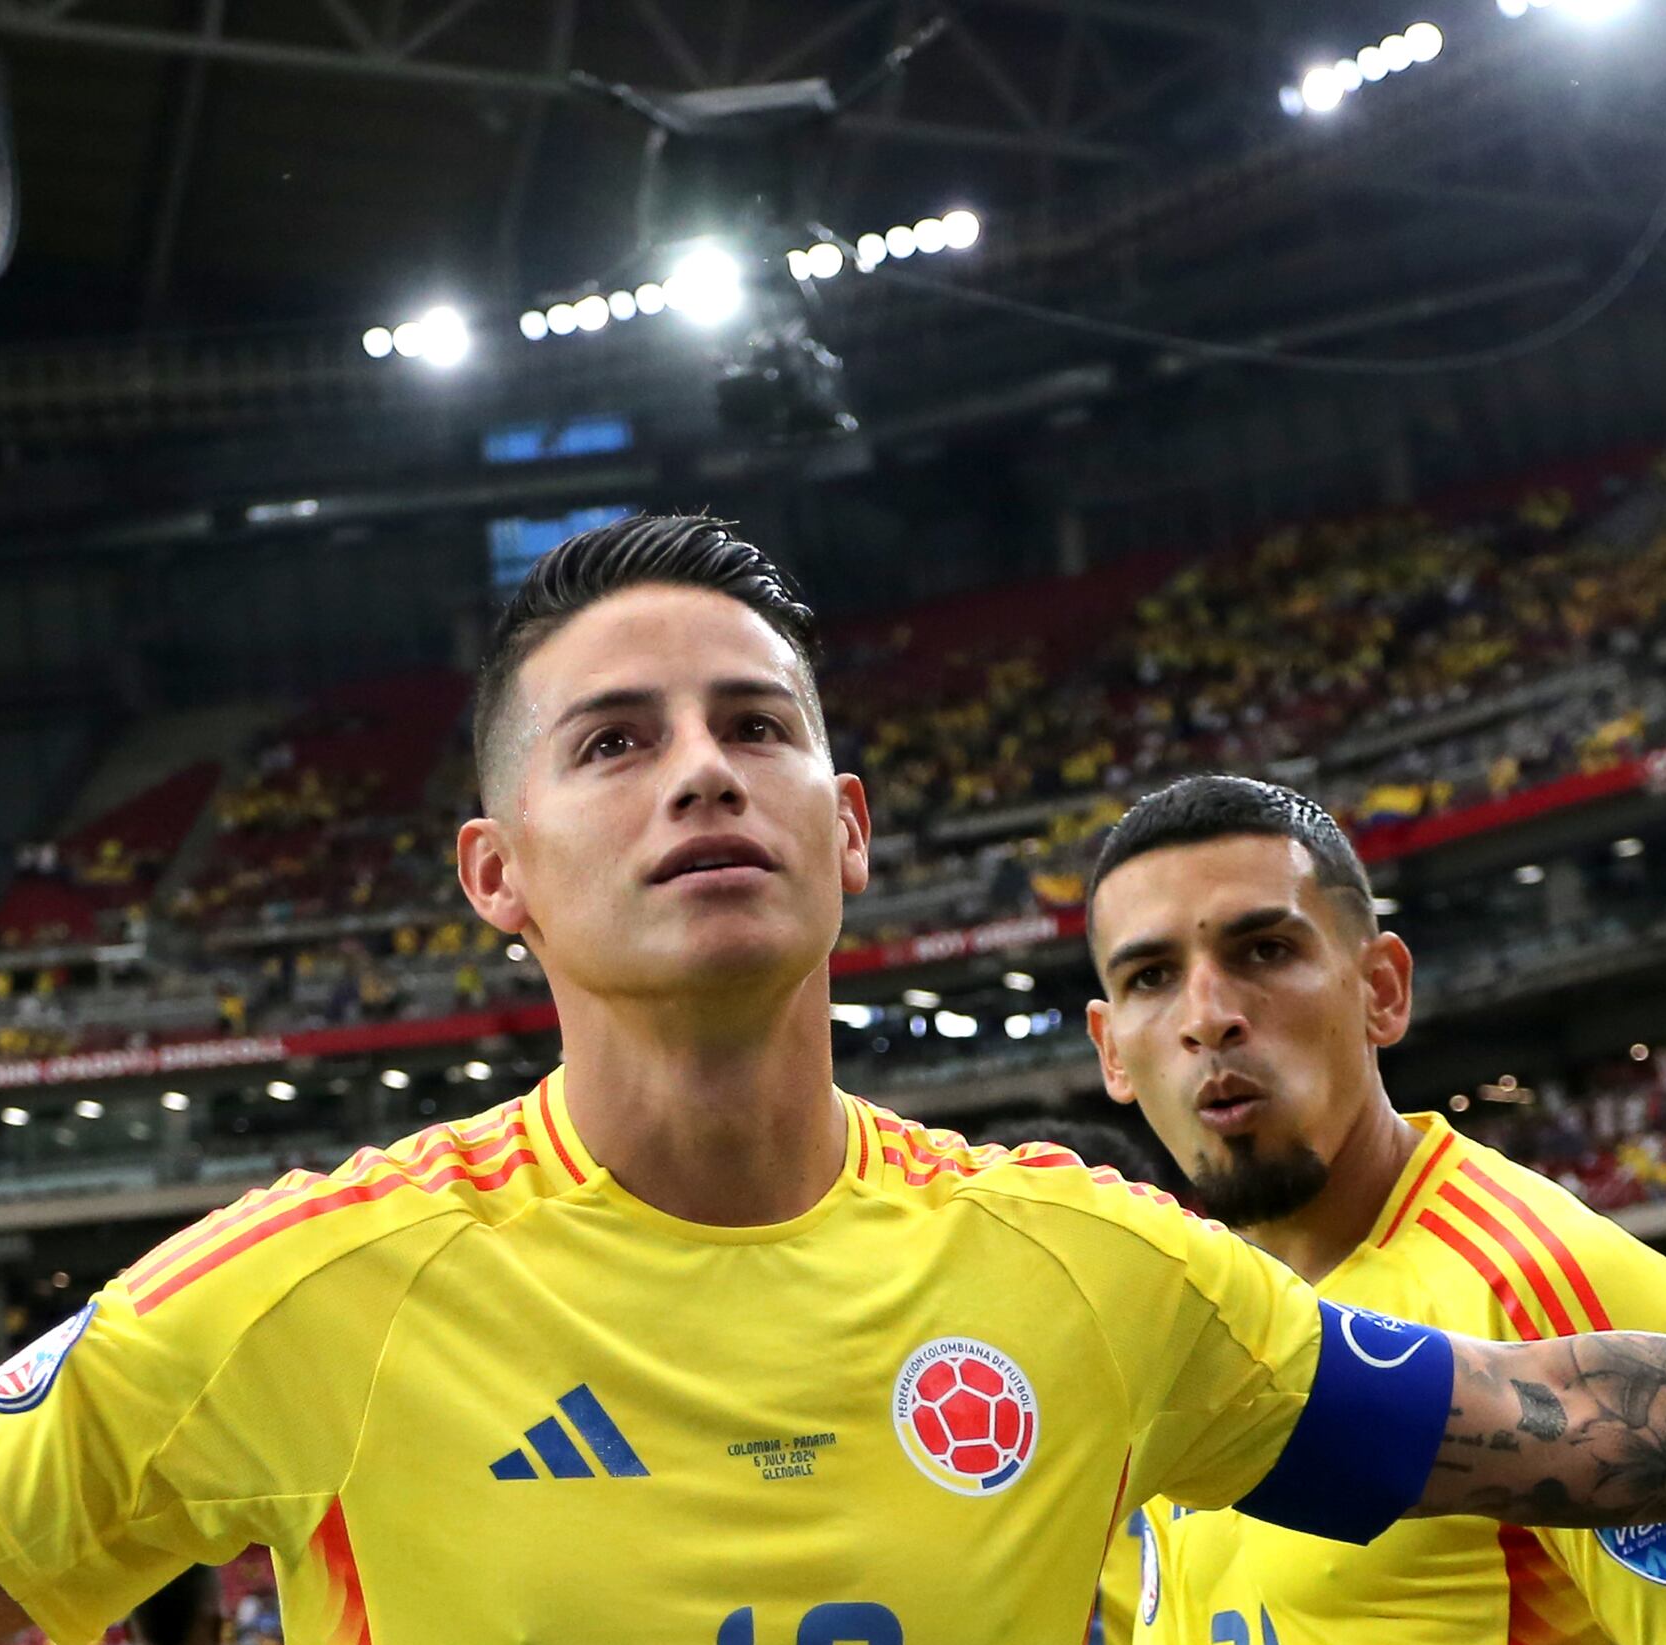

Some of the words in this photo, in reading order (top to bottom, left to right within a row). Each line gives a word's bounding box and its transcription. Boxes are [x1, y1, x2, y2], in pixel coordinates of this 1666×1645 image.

[923, 1342, 991, 1362] COLOMBIANA
[992, 1354, 1006, 1369] DE
[727, 1439, 782, 1457] COLOMBIA
[793, 1432, 838, 1450] PANAMA
[753, 1454, 761, 1468] 6
[764, 1453, 787, 1467] JULY
[790, 1449, 817, 1464] 2024
[762, 1463, 815, 1481] GLENDALE
